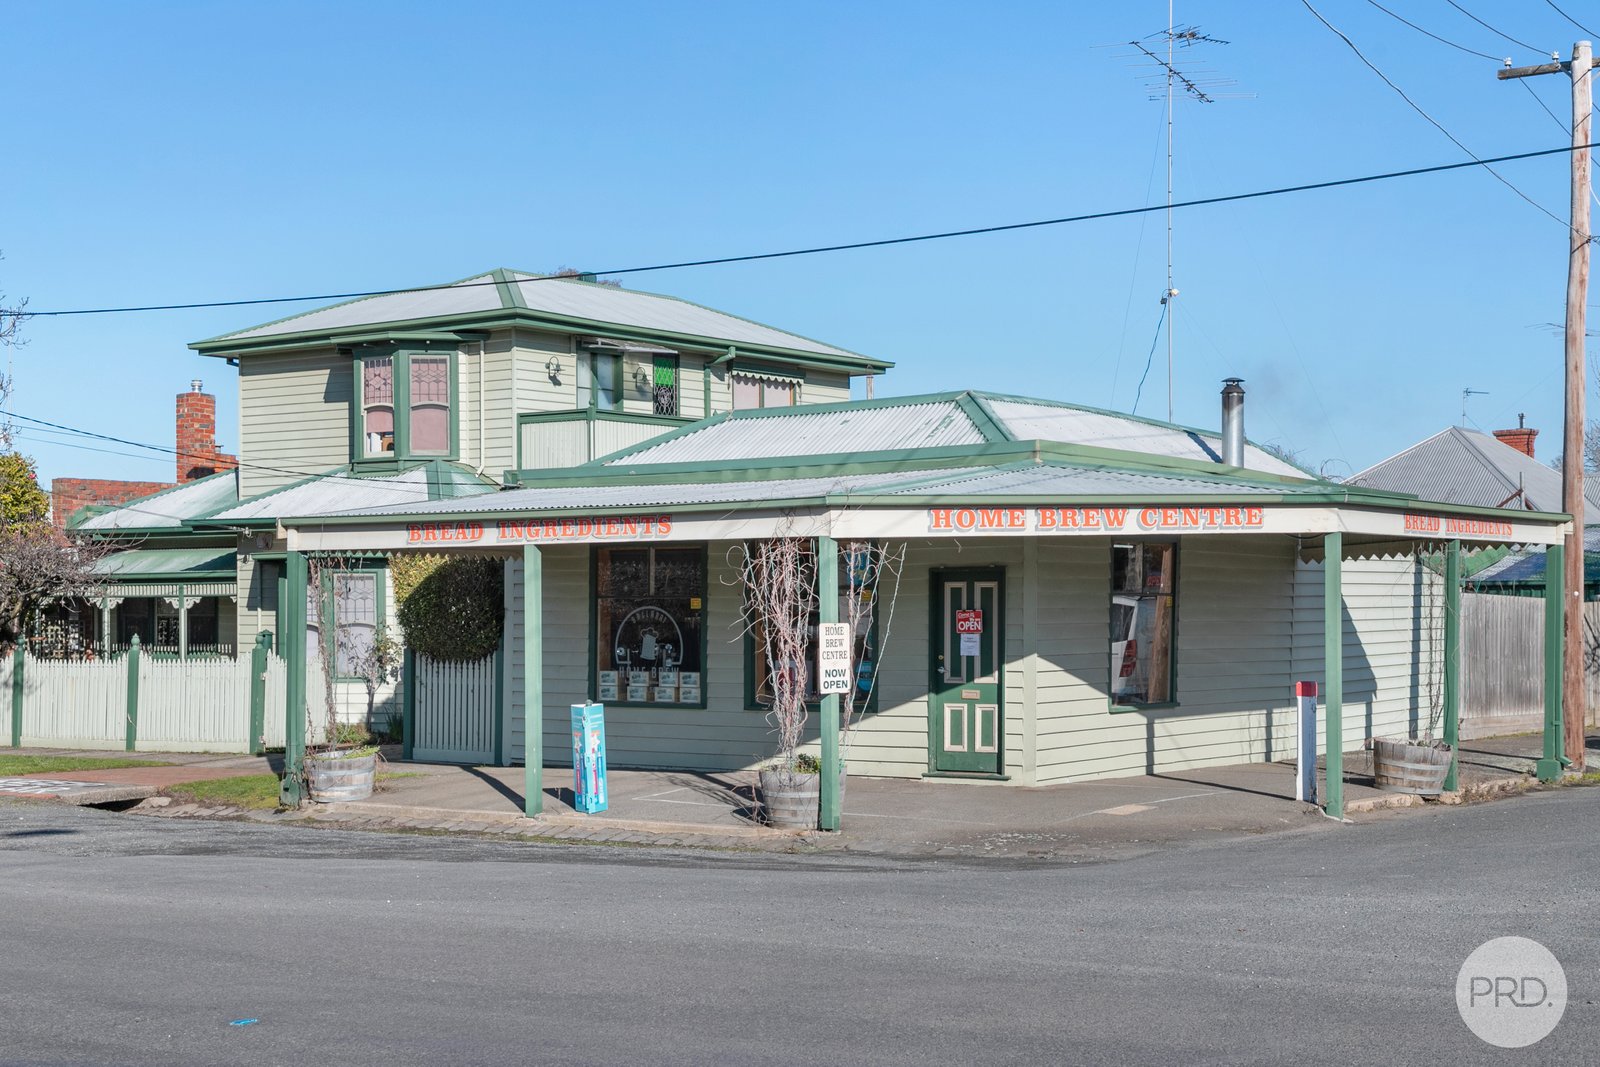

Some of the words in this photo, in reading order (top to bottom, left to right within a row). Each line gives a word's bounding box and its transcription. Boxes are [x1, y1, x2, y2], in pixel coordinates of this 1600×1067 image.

[928, 508, 1026, 532] HOME
[1036, 508, 1128, 531] BREW
[1138, 507, 1264, 531] CENTRE
[407, 522, 484, 544] BREAD
[497, 515, 672, 542] INGREDIENTS
[1404, 513, 1440, 534] BREAD
[1445, 517, 1512, 538] INGREDIENTS
[825, 626, 844, 636] HOME
[958, 621, 981, 631] OPEN
[825, 638, 844, 648] BREW
[822, 650, 847, 660] CENTRE
[824, 668, 847, 678] NOW
[823, 680, 848, 690] OPEN
